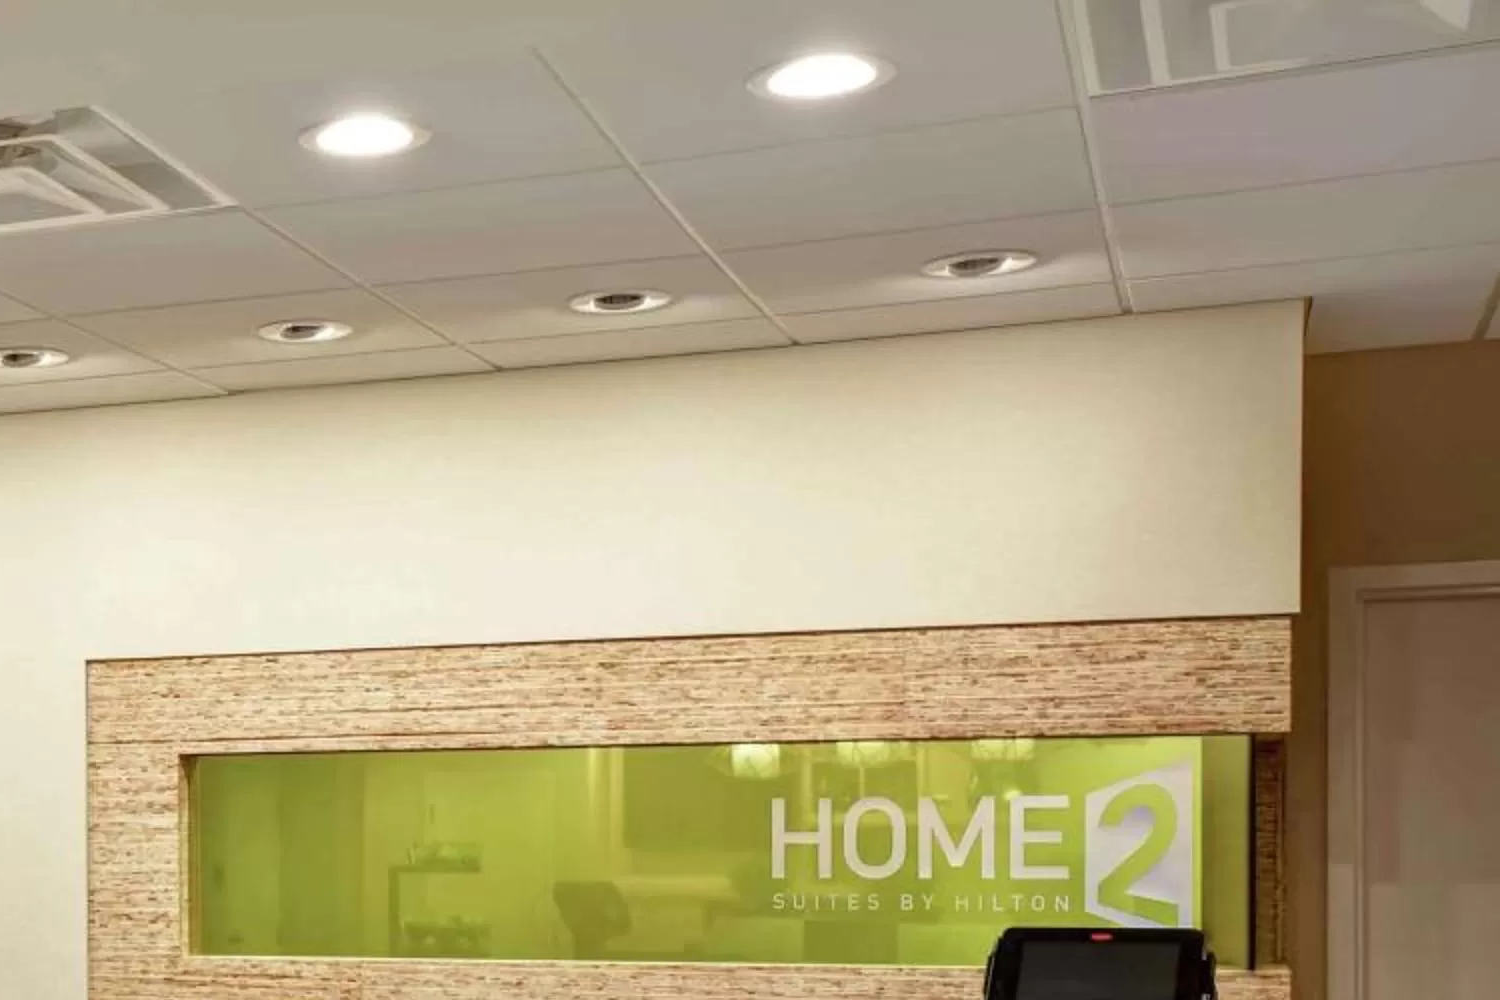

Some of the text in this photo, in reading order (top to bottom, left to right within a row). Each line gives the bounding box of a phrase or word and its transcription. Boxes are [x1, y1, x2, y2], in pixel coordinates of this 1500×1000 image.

[771, 795, 1071, 880] HOME
[771, 892, 1071, 913] SUITES BY HILTON
